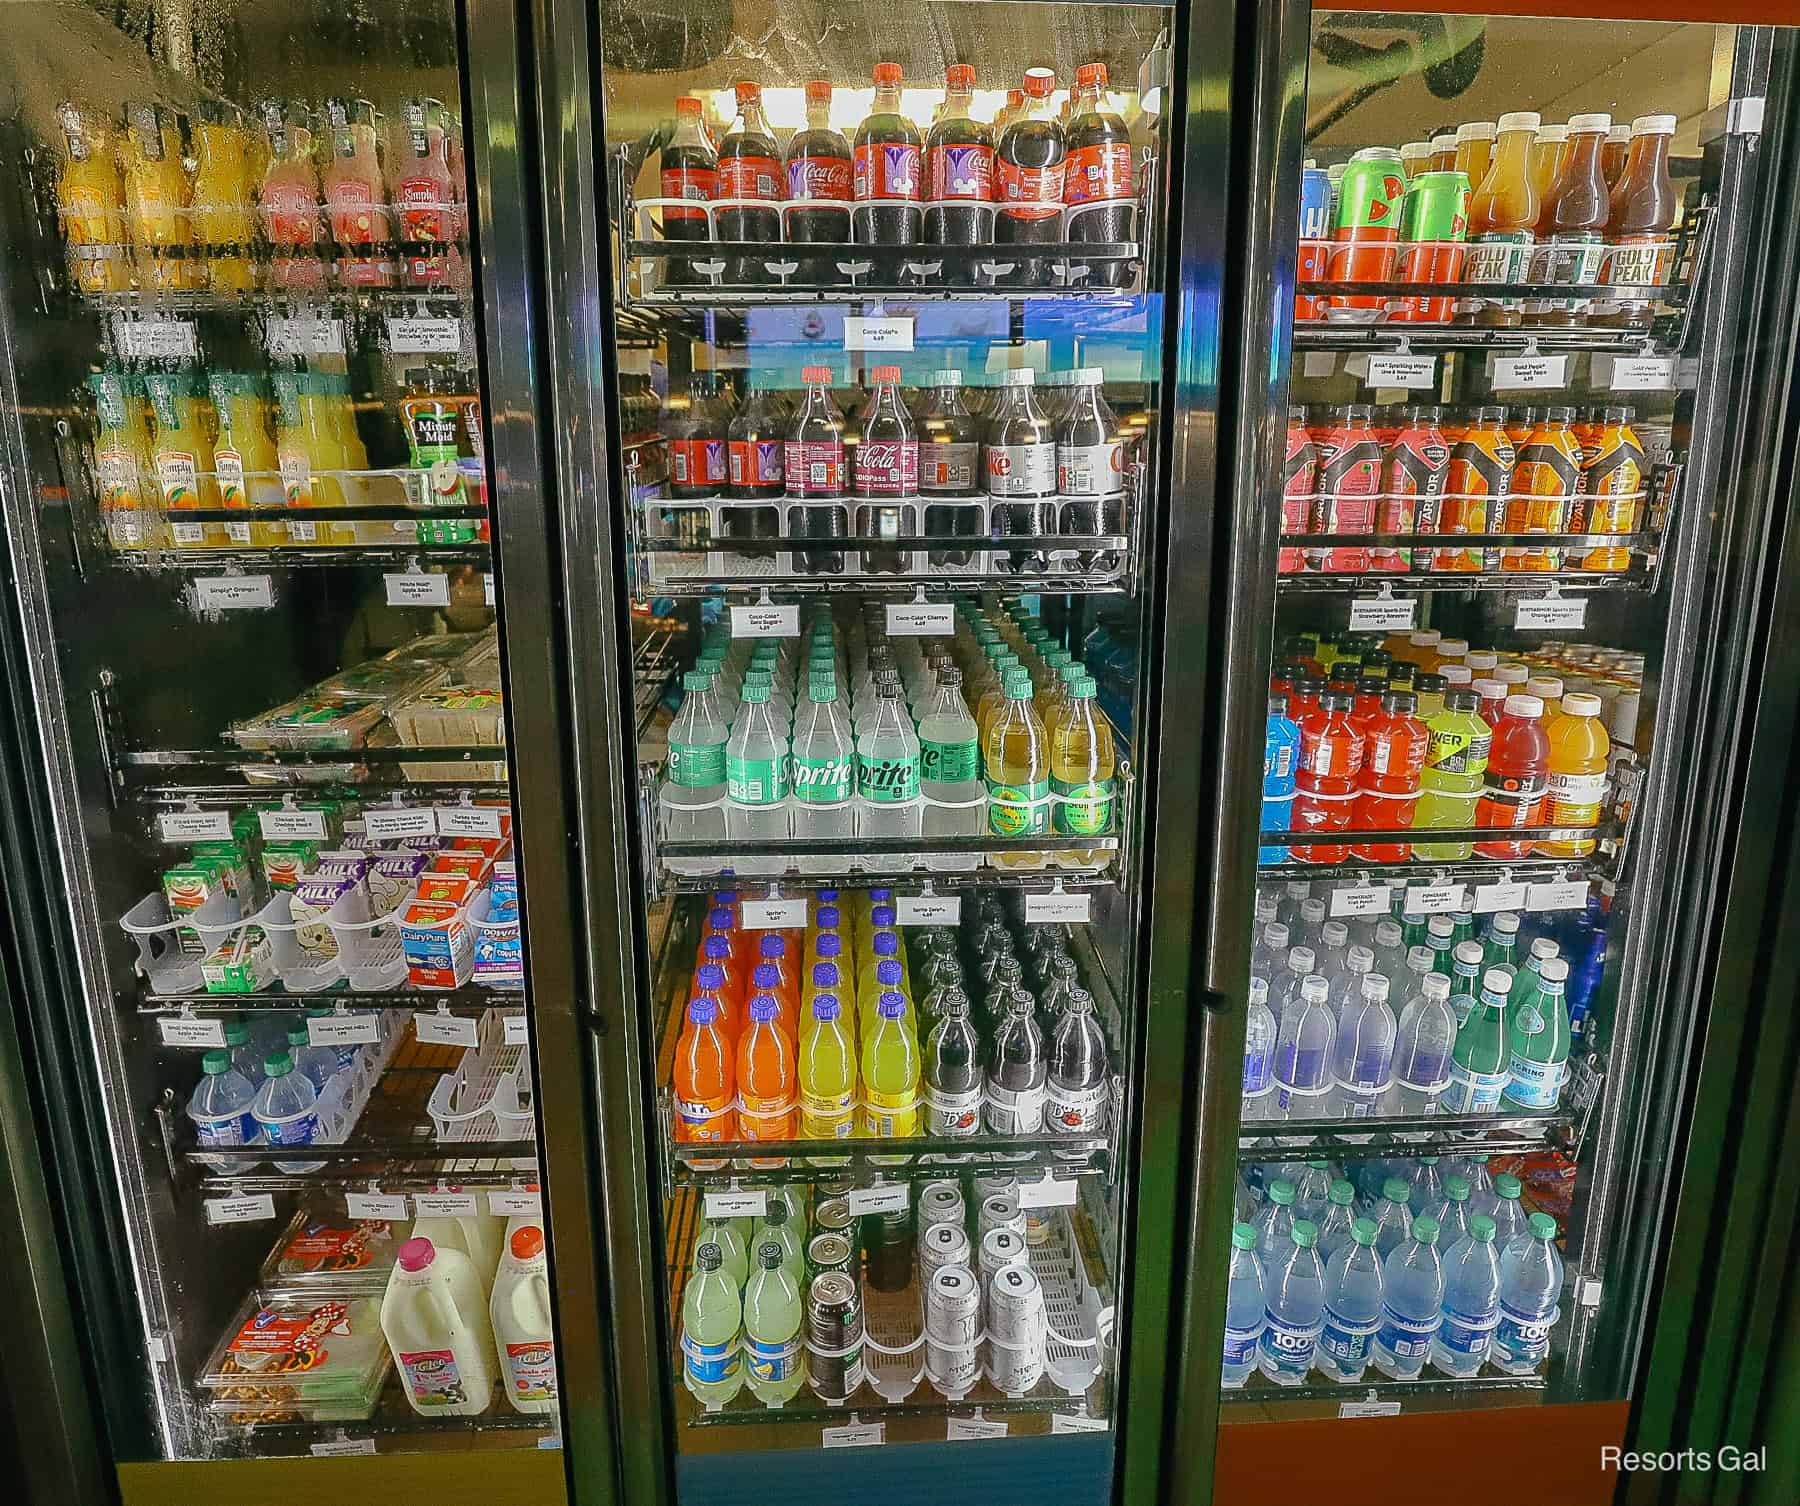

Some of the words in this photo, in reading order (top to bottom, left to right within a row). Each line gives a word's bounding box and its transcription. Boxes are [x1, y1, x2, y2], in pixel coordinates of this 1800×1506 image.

[1615, 248, 1654, 266] GOLD
[1466, 261, 1504, 279] PEAK
[1613, 264, 1651, 281] PEAK
[418, 420, 457, 432] Minute
[863, 445, 899, 468] Cola
[859, 760, 911, 786] prite
[318, 862, 361, 877] MILK
[374, 861, 417, 873] MILK
[295, 885, 340, 899] MILK
[403, 930, 447, 942] DairyPure
